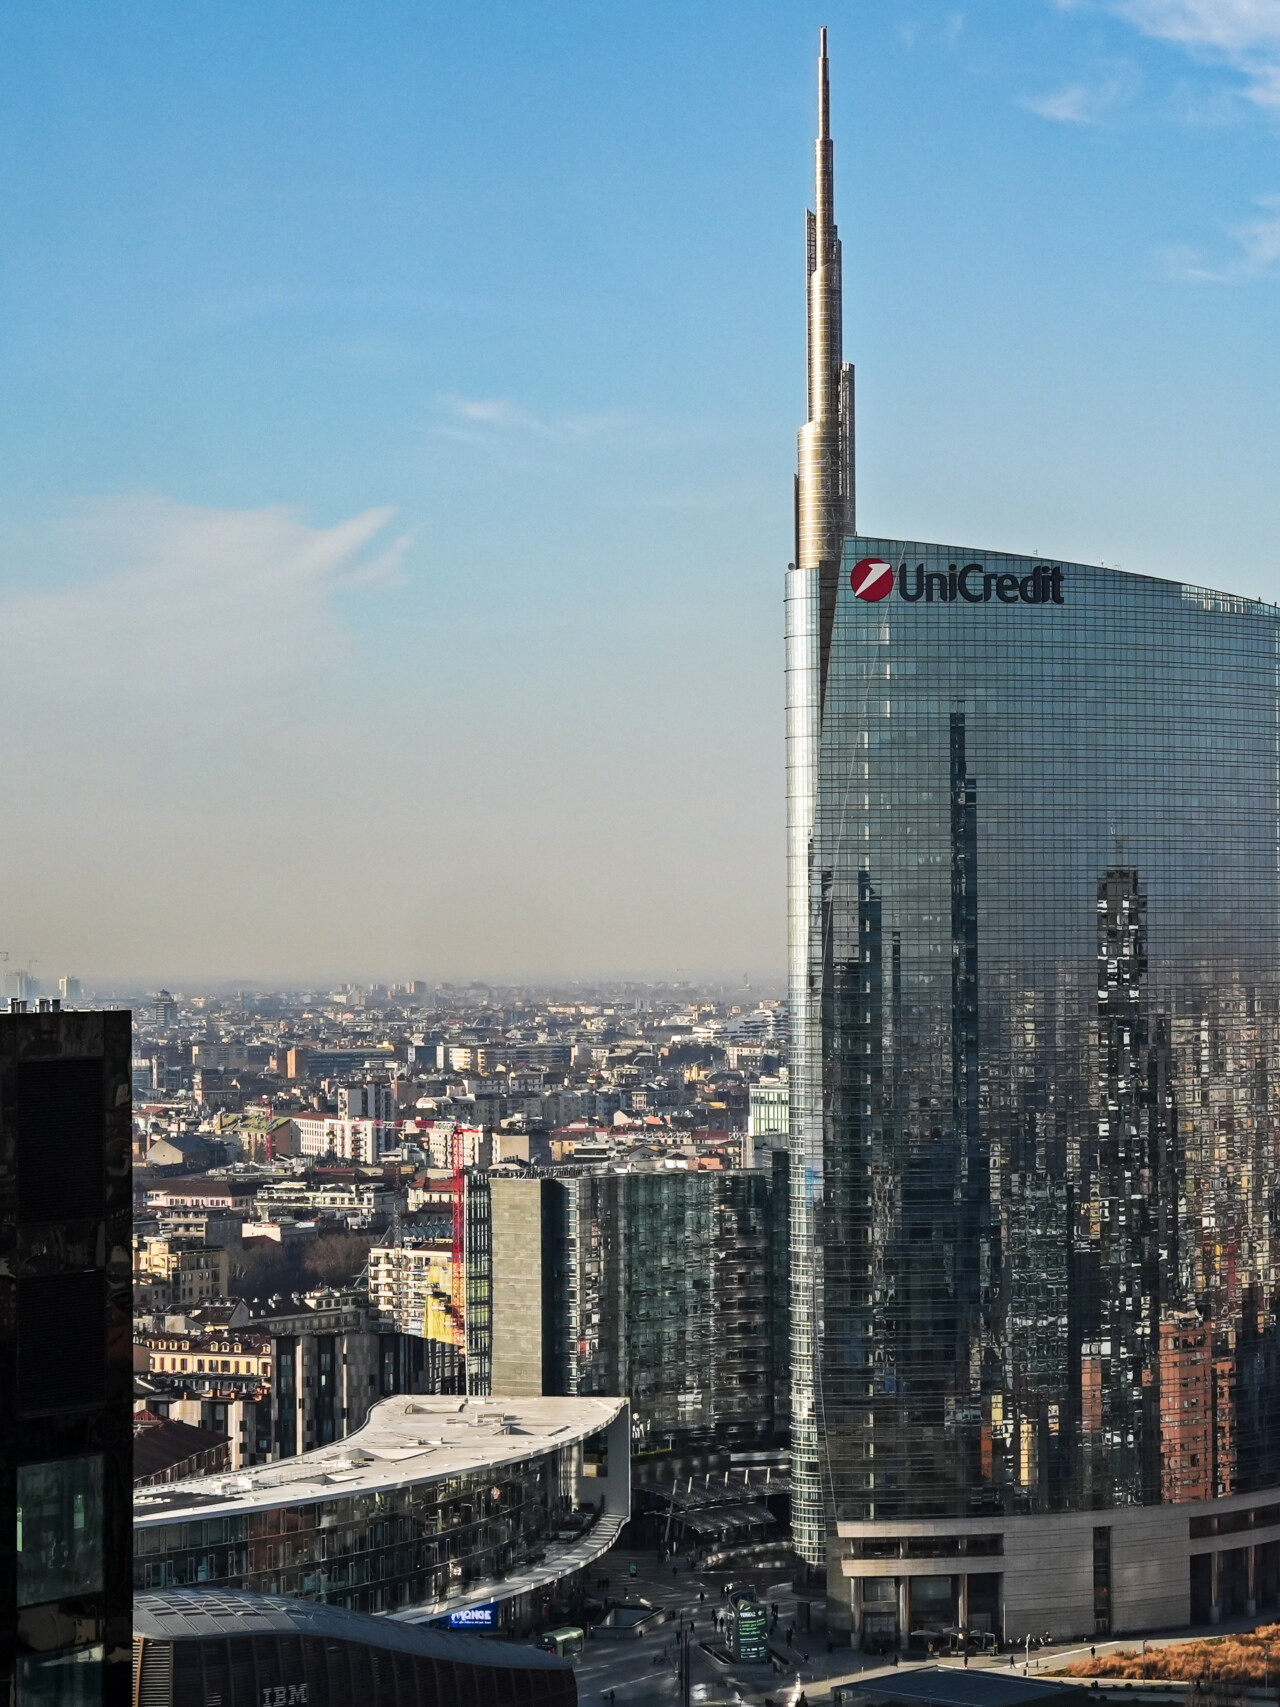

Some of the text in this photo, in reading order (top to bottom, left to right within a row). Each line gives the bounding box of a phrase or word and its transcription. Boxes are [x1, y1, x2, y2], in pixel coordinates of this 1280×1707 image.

[899, 563, 1064, 604] UniCredit
[451, 1610, 491, 1620] MONGE
[263, 1683, 308, 1707] IBM
